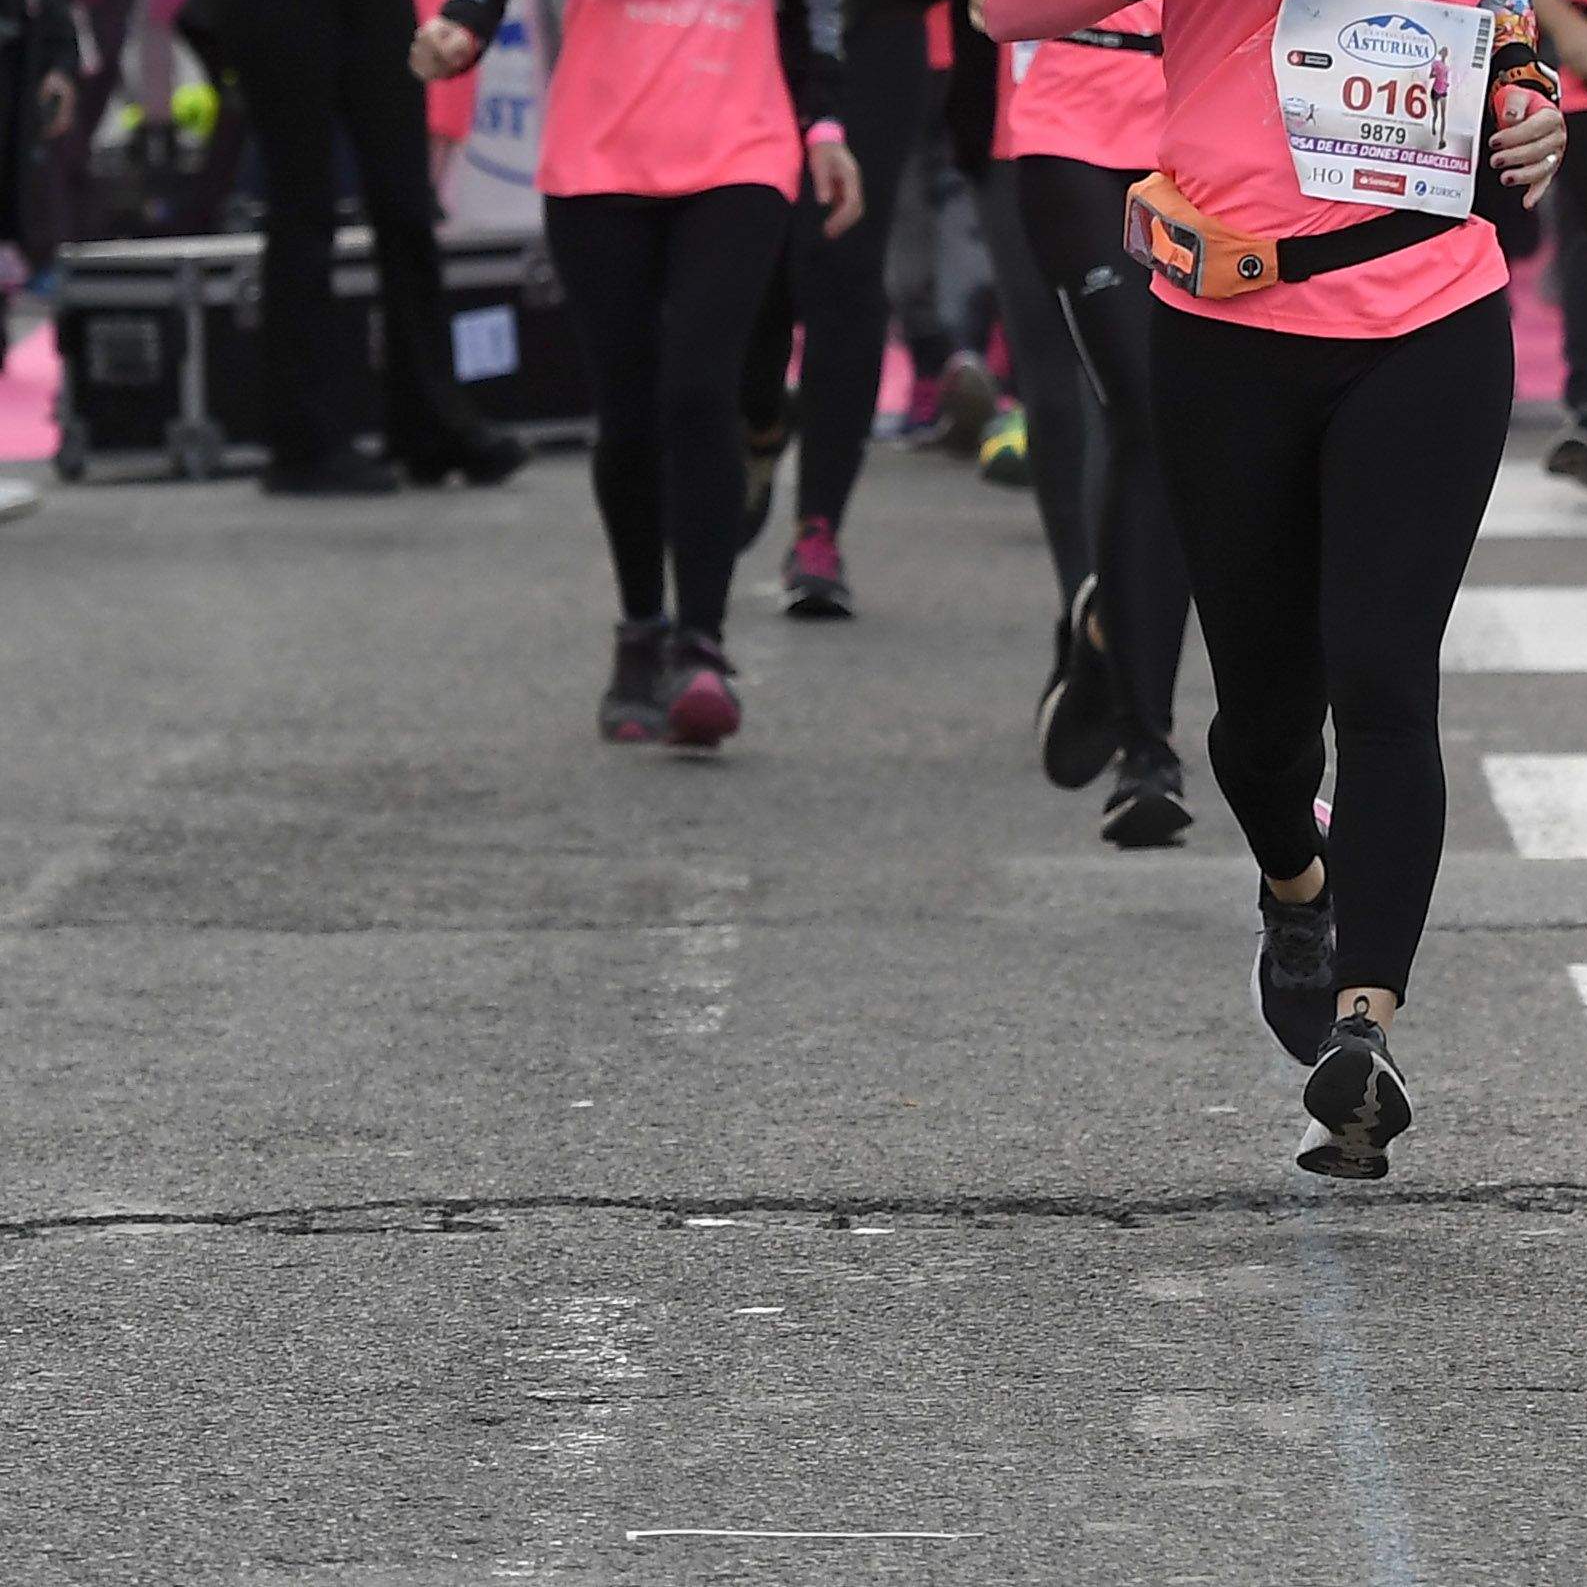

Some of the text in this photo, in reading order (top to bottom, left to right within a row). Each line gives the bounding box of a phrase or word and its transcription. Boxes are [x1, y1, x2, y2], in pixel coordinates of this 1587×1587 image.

[1346, 29, 1430, 59] ASTURIANA
[1342, 76, 1427, 119] 016
[1360, 123, 1406, 144] 9879
[1316, 140, 1333, 152] DE
[1334, 142, 1359, 156] LES
[1360, 146, 1400, 161] DONES
[1401, 151, 1416, 163] DE
[1416, 153, 1470, 172] BARCELONA
[1429, 186, 1462, 199] ZURICH
